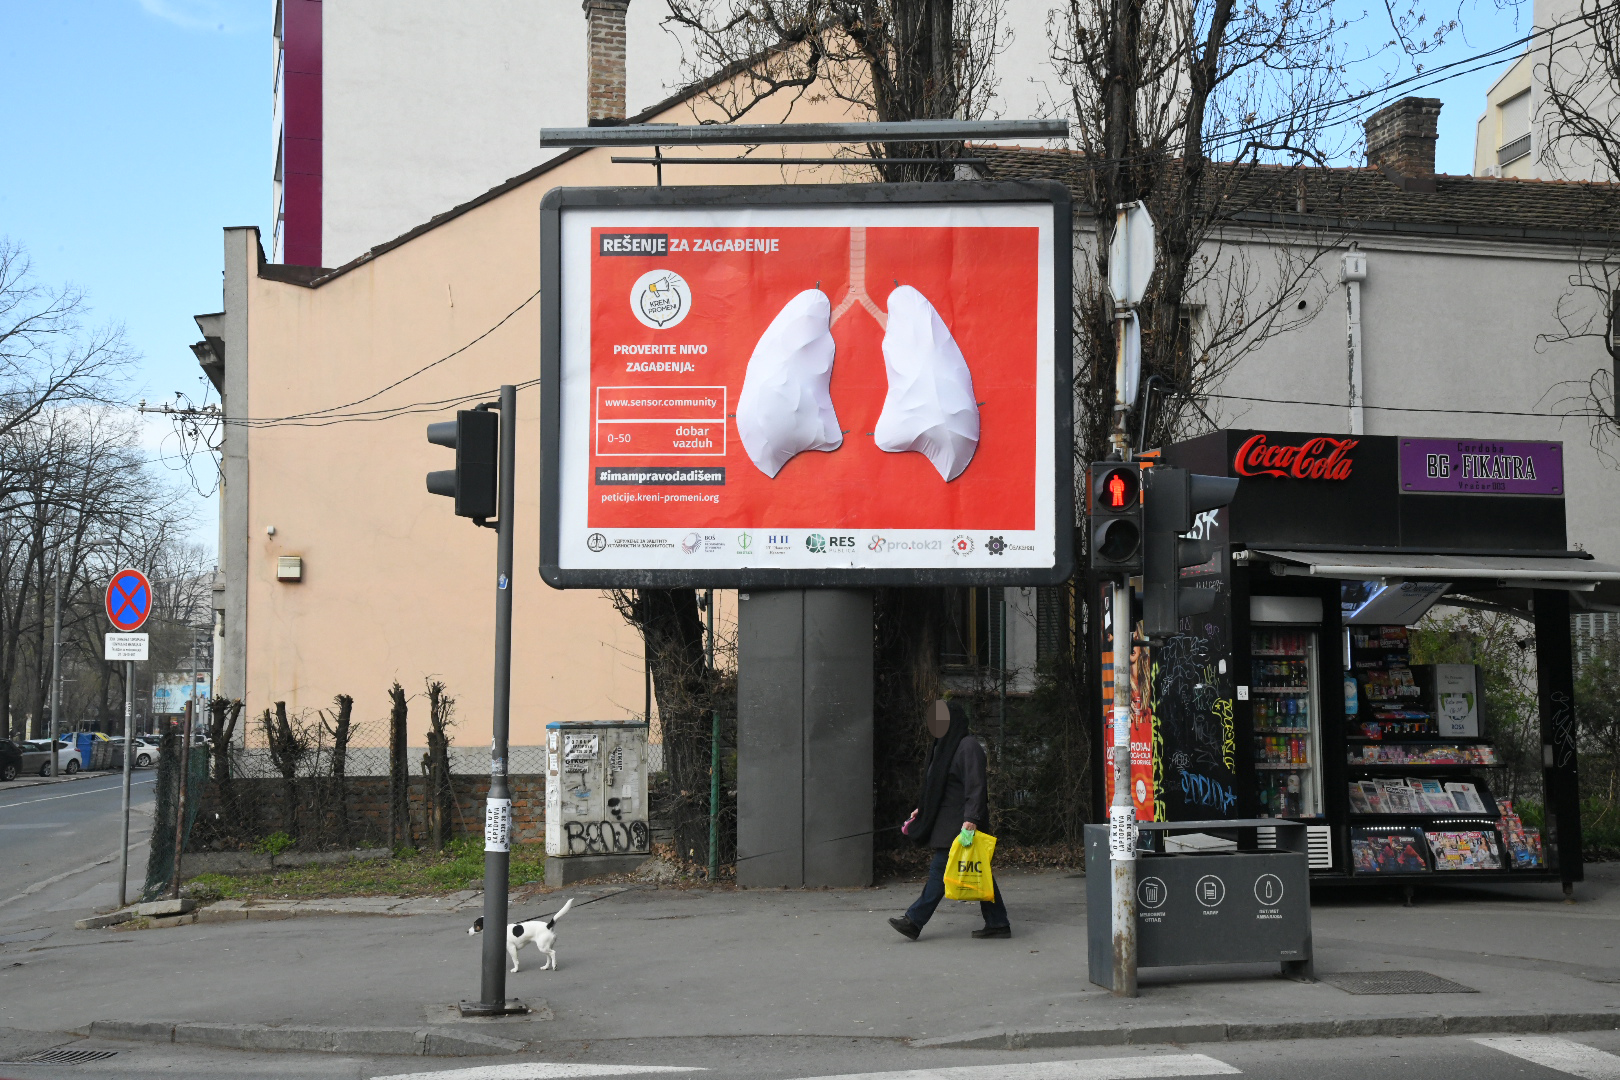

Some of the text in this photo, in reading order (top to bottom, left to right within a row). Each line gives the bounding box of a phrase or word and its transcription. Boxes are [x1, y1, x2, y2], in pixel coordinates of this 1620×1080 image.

[603, 235, 780, 254] REŠENJE ZA ZAGAĐENJE
[649, 298, 670, 308] KRENI
[648, 304, 677, 315] PROMENI
[613, 344, 708, 355] PROVERITE NIVO
[625, 362, 695, 373] ZAGAĐENJA:
[605, 397, 717, 409] www.sensor.community
[675, 425, 710, 437] dobar
[607, 433, 632, 443] 0-50
[672, 437, 713, 448] vazduh
[1457, 442, 1504, 454] Cordoba
[1426, 453, 1537, 481] BG FIKATRA
[599, 469, 722, 484] #imampravodadišem
[601, 492, 720, 504] peticije.kreni-promeni.org
[829, 536, 856, 547] RES
[887, 540, 943, 552] pro.tok21
[957, 860, 983, 873] БИС
